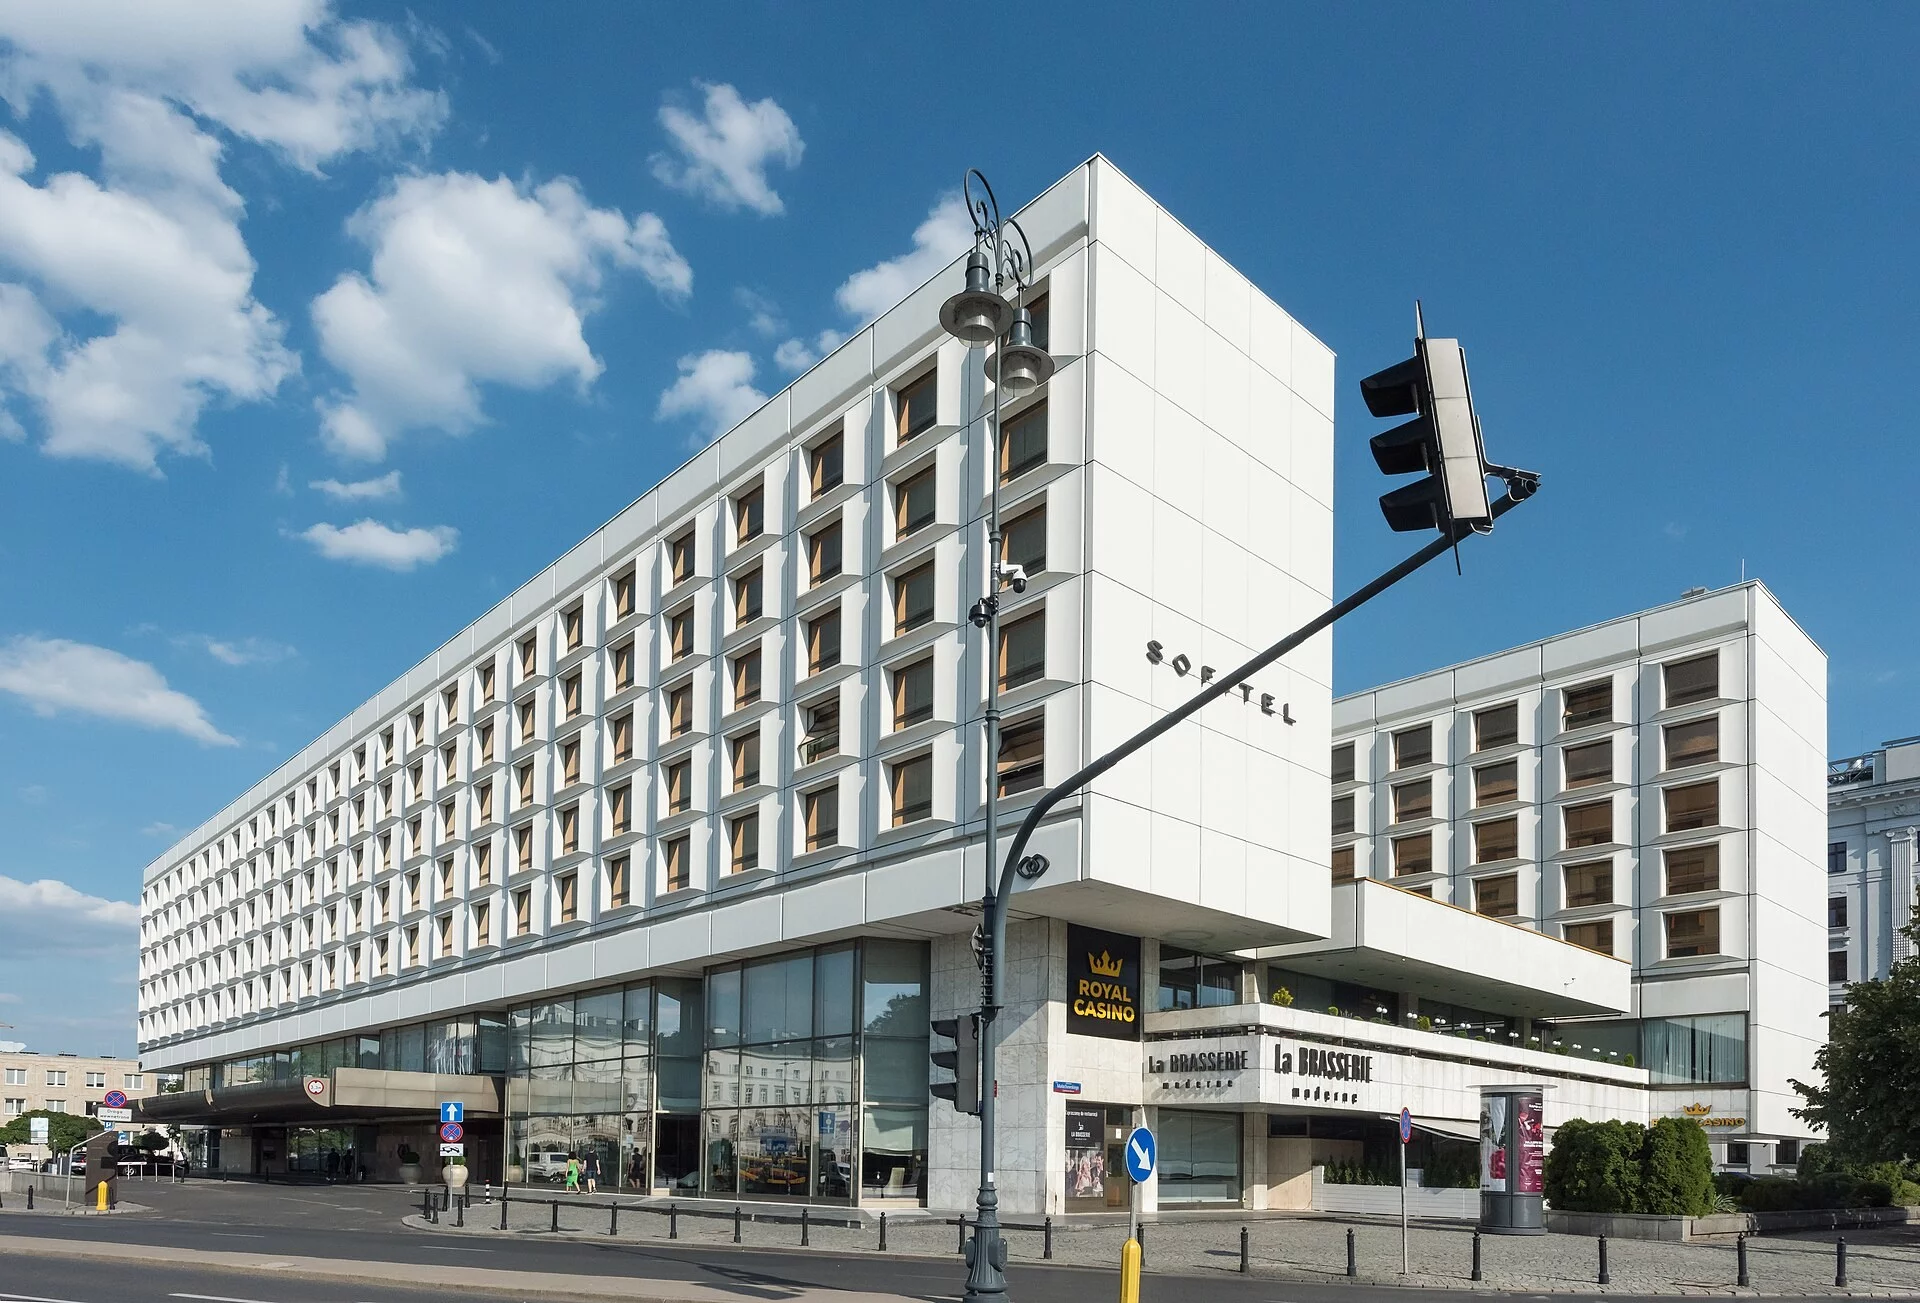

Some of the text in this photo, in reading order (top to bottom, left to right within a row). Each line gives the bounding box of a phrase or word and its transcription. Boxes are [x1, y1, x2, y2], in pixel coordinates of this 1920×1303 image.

[1145, 640, 1297, 726] SOFTEL
[1079, 979, 1132, 1003] ROYAL
[1074, 998, 1135, 1022] CASINO
[1148, 1050, 1249, 1074] La BRASSERIE
[1274, 1043, 1373, 1083] La BRASSERIE
[1162, 1079, 1233, 1090] moderne
[1291, 1086, 1358, 1104] moderne
[1695, 1117, 1746, 1127] CASINO
